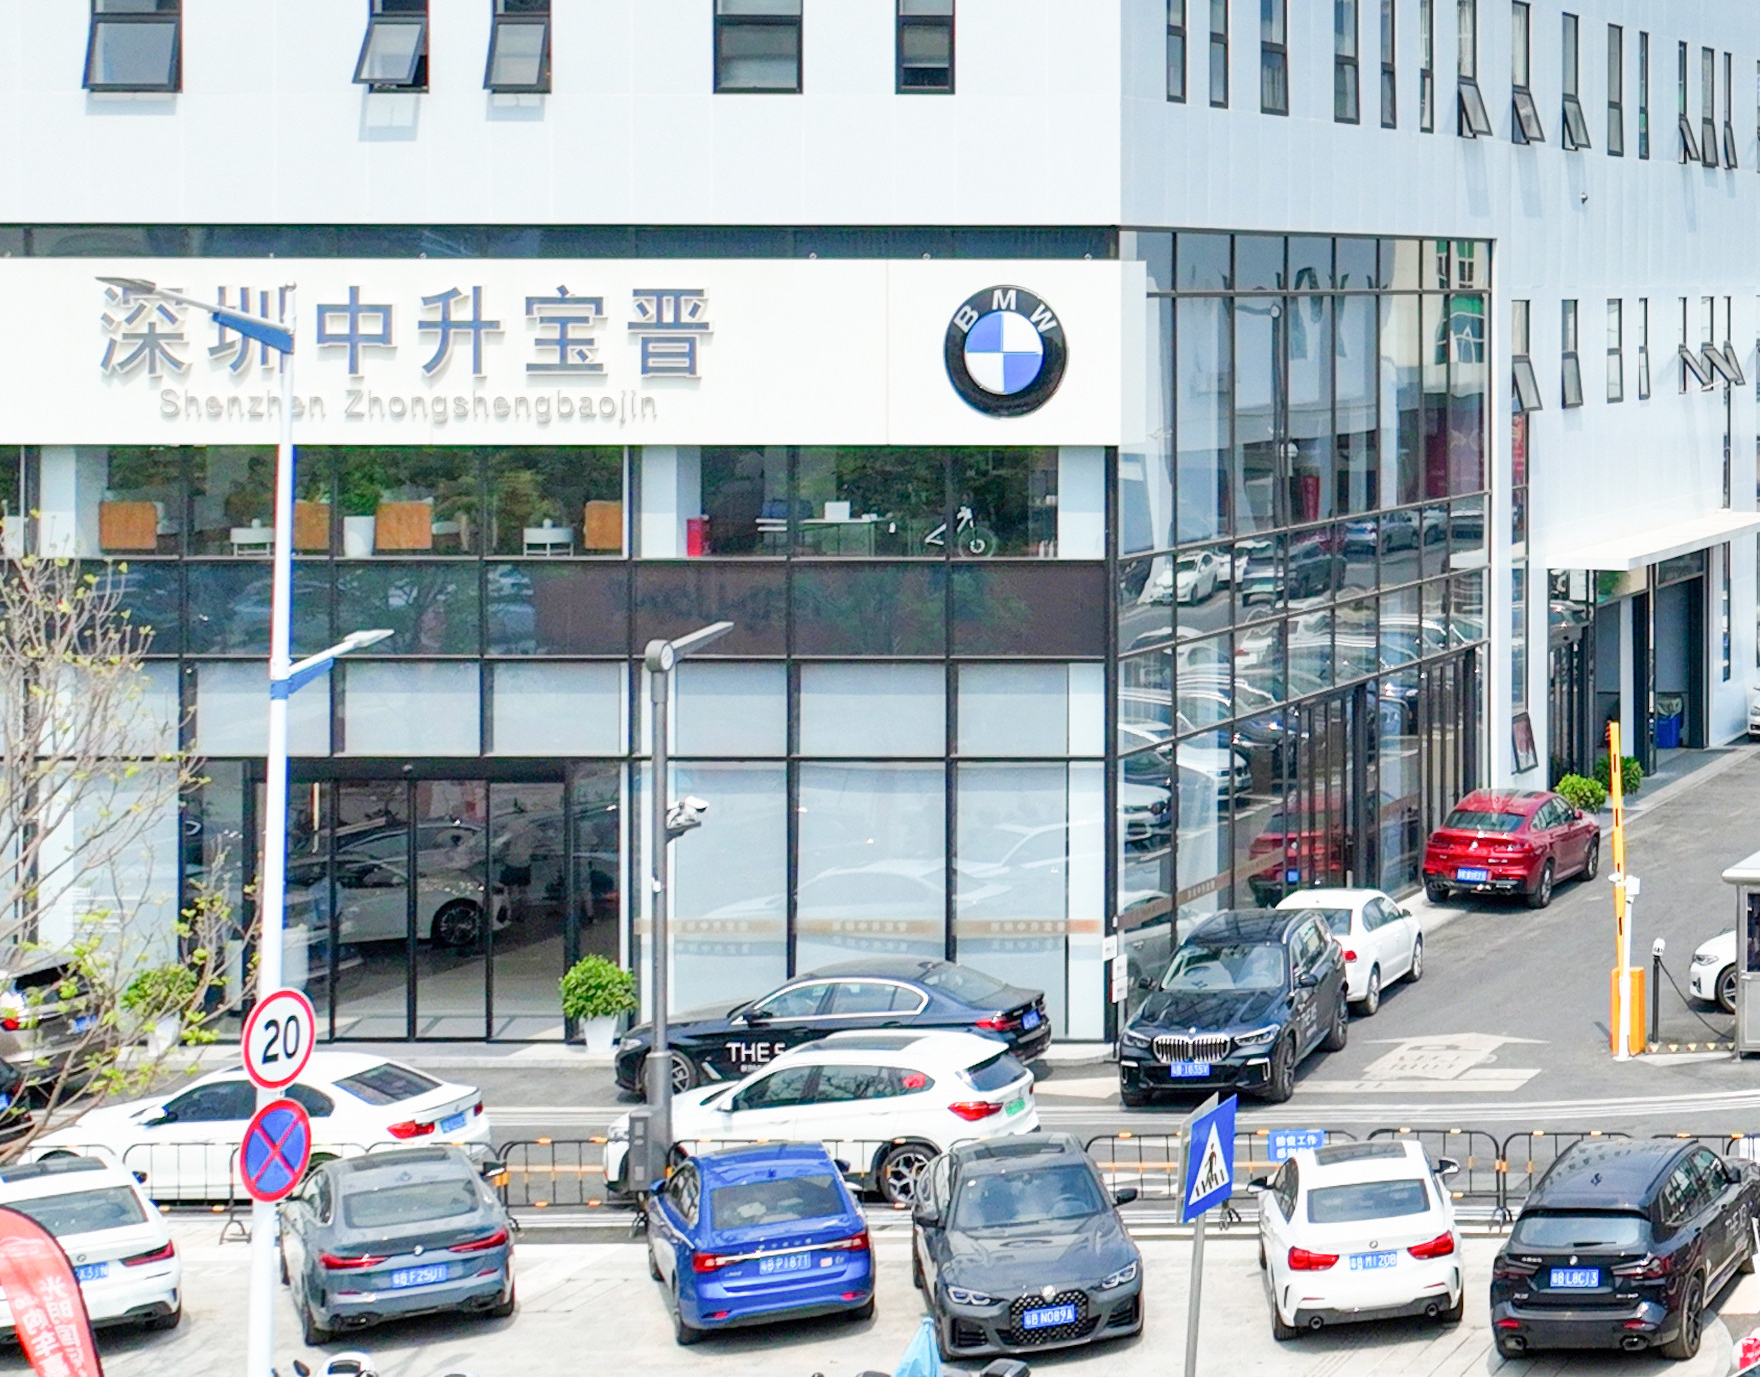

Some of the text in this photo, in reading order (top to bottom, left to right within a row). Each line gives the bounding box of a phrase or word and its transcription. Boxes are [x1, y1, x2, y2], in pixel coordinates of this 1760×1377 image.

[953, 288, 1058, 334] BMW
[344, 389, 658, 429] Zhongshengbaojin
[261, 1015, 301, 1065] 20
[726, 1042, 770, 1063] THE
